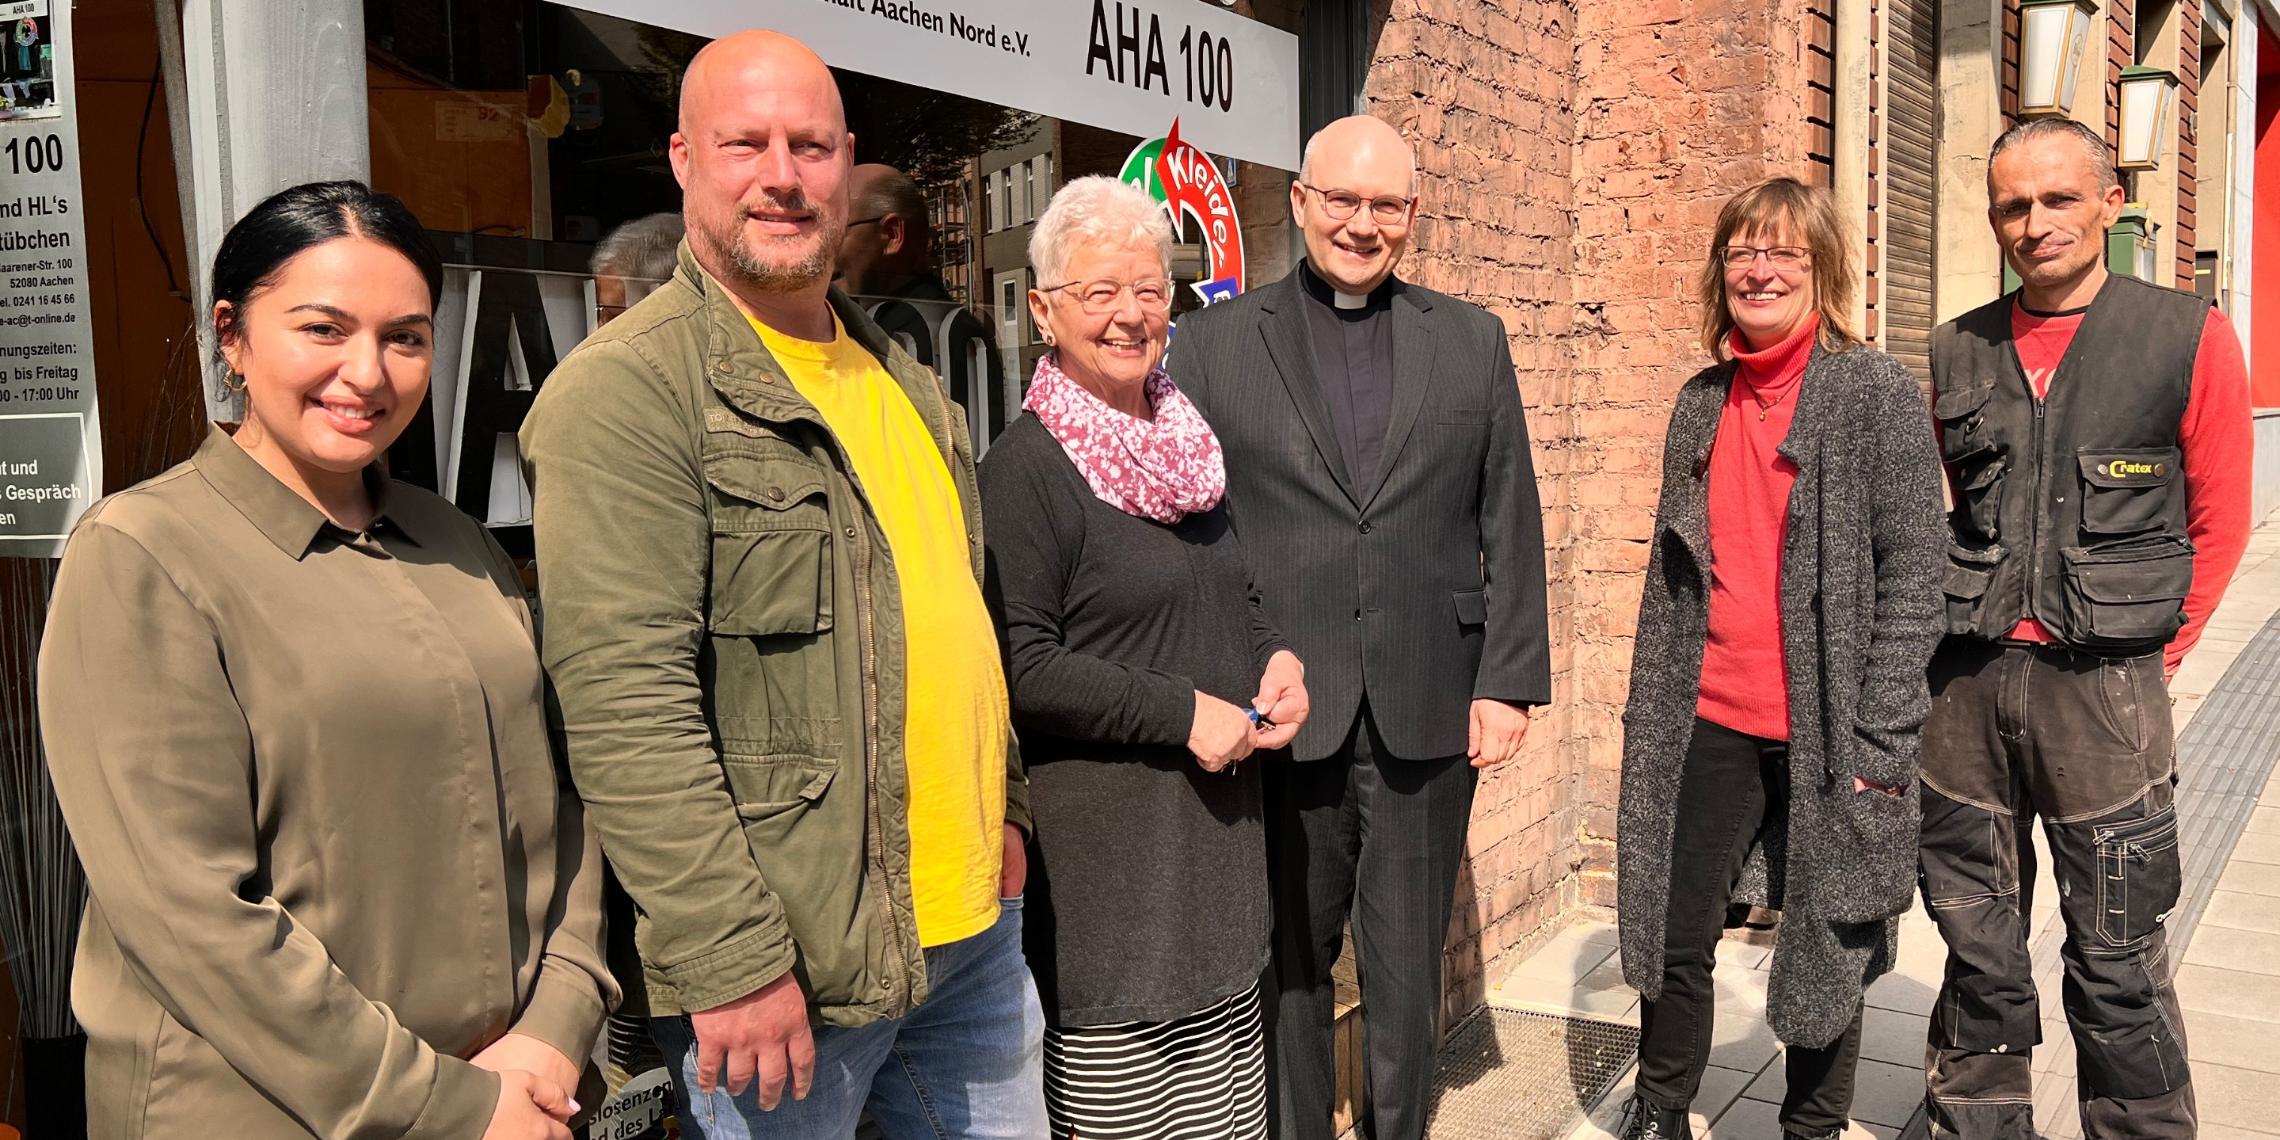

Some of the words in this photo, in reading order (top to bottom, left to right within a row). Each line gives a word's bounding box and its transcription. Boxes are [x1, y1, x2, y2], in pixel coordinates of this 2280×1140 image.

[871, 0, 943, 33] Aachen
[949, 12, 996, 48] Nord
[1001, 31, 1030, 57] e.V.
[1086, 0, 1170, 96] AHA
[1180, 24, 1233, 112] 100
[5, 133, 64, 174] 100
[1166, 146, 1229, 270] Kleider
[0, 261, 55, 273] aarener-Str.
[57, 258, 73, 269] 100
[10, 276, 38, 288] 52080
[40, 275, 74, 287] Aachen
[13, 296, 35, 306] 0241
[39, 295, 49, 305] 16
[51, 294, 62, 305] 45
[64, 293, 75, 304] 66
[15, 367, 33, 380] bis
[36, 366, 78, 382] Freitag
[22, 387, 53, 402] 17:00
[56, 386, 79, 400] Uhr
[10, 459, 38, 475] und
[5, 483, 81, 503] Gespräch
